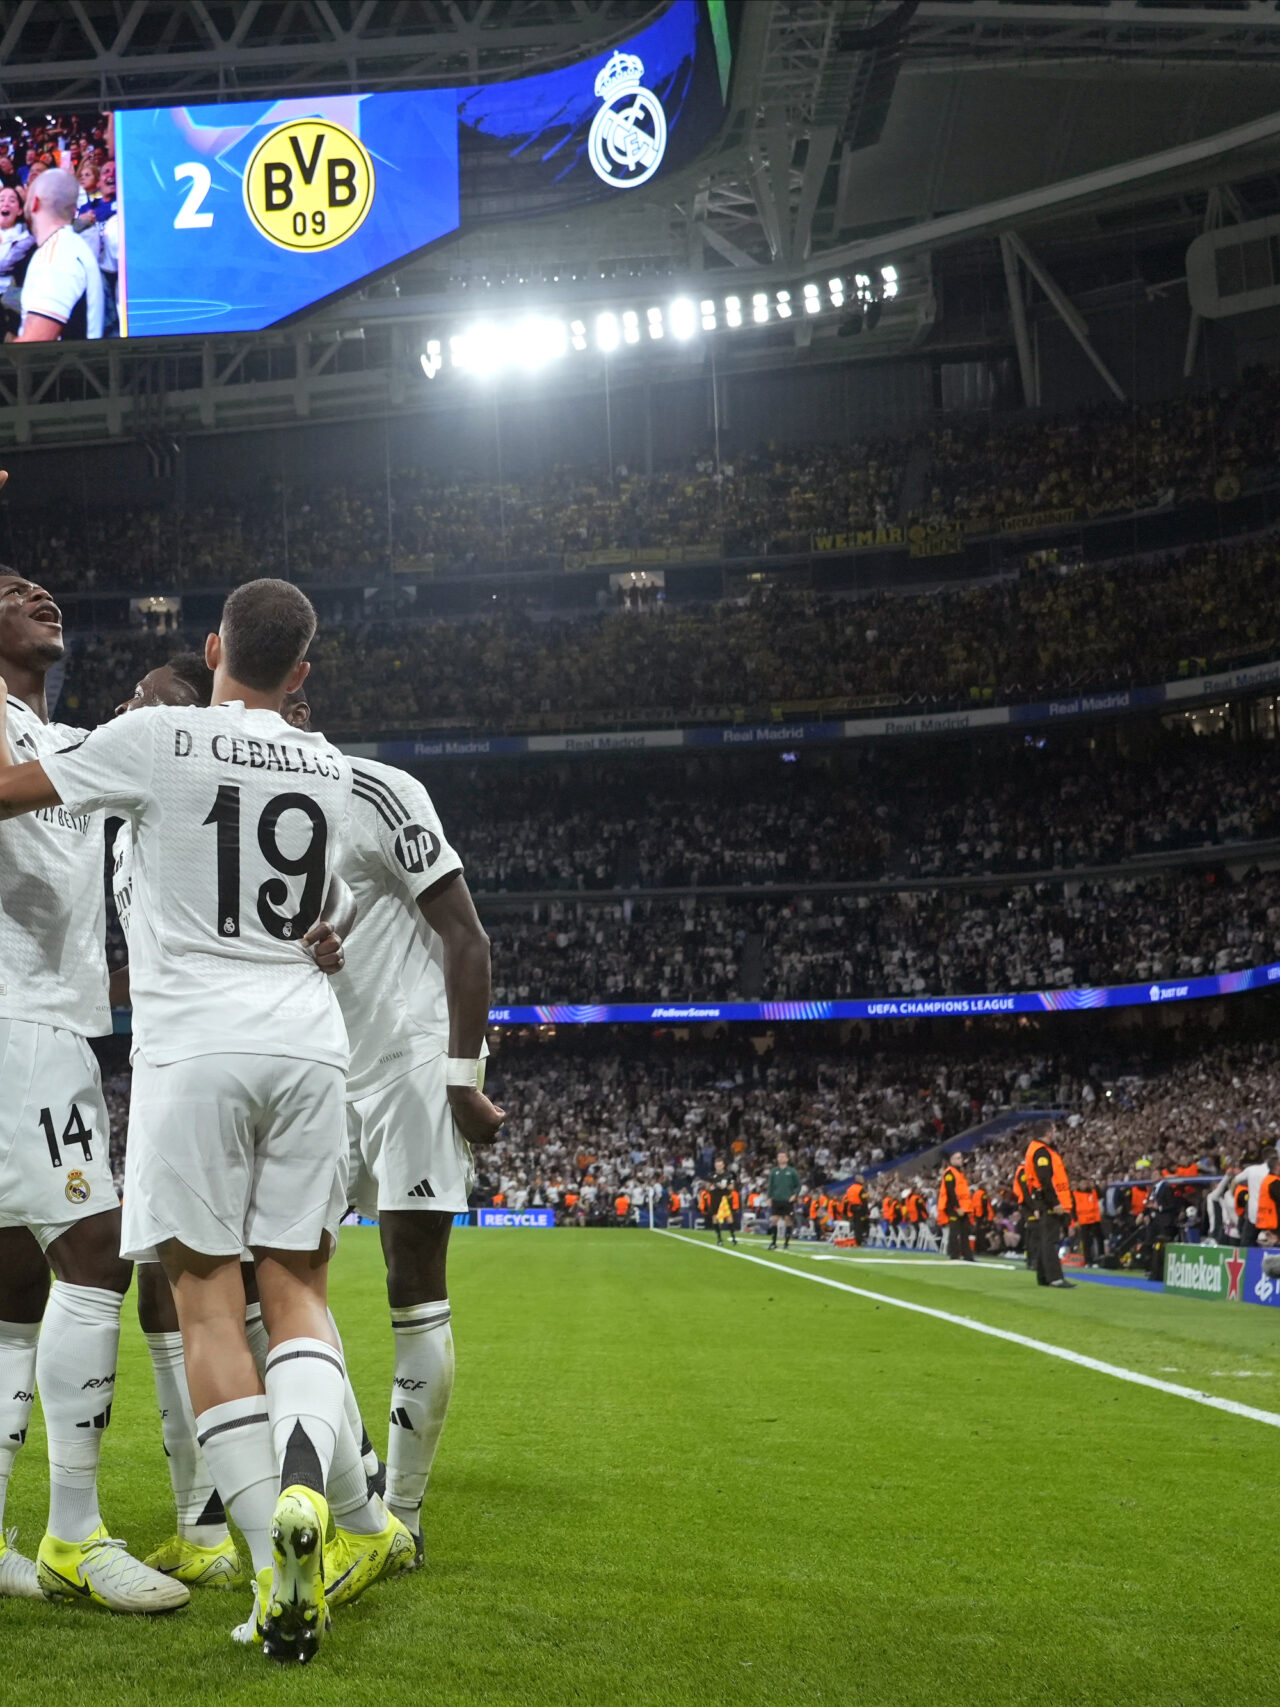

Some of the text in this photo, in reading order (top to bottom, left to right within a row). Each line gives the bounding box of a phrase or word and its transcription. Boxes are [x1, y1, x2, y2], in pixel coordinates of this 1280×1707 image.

[264, 134, 357, 212] BVB
[173, 161, 214, 229] 2
[293, 210, 325, 236] 09
[1203, 678, 1233, 693] Real
[1049, 693, 1130, 717] Real Madrid
[723, 727, 804, 743] Real Madrid
[885, 717, 970, 735] Real Madrid
[414, 741, 490, 755] Real Madrid
[565, 736, 645, 751] Real Madrid
[173, 729, 340, 781] D. CEBALLOS
[398, 828, 434, 871] hp
[202, 784, 328, 940] 19
[1160, 986, 1189, 999] JUST EAT
[488, 1010, 510, 1020] GUE
[867, 998, 1014, 1015] UEFA CHAMPIONS LEAGUE
[38, 1103, 93, 1168] 14
[484, 1213, 548, 1226] RECYCLE
[1166, 1253, 1222, 1293] Heineken
[393, 1376, 427, 1391] MCF
